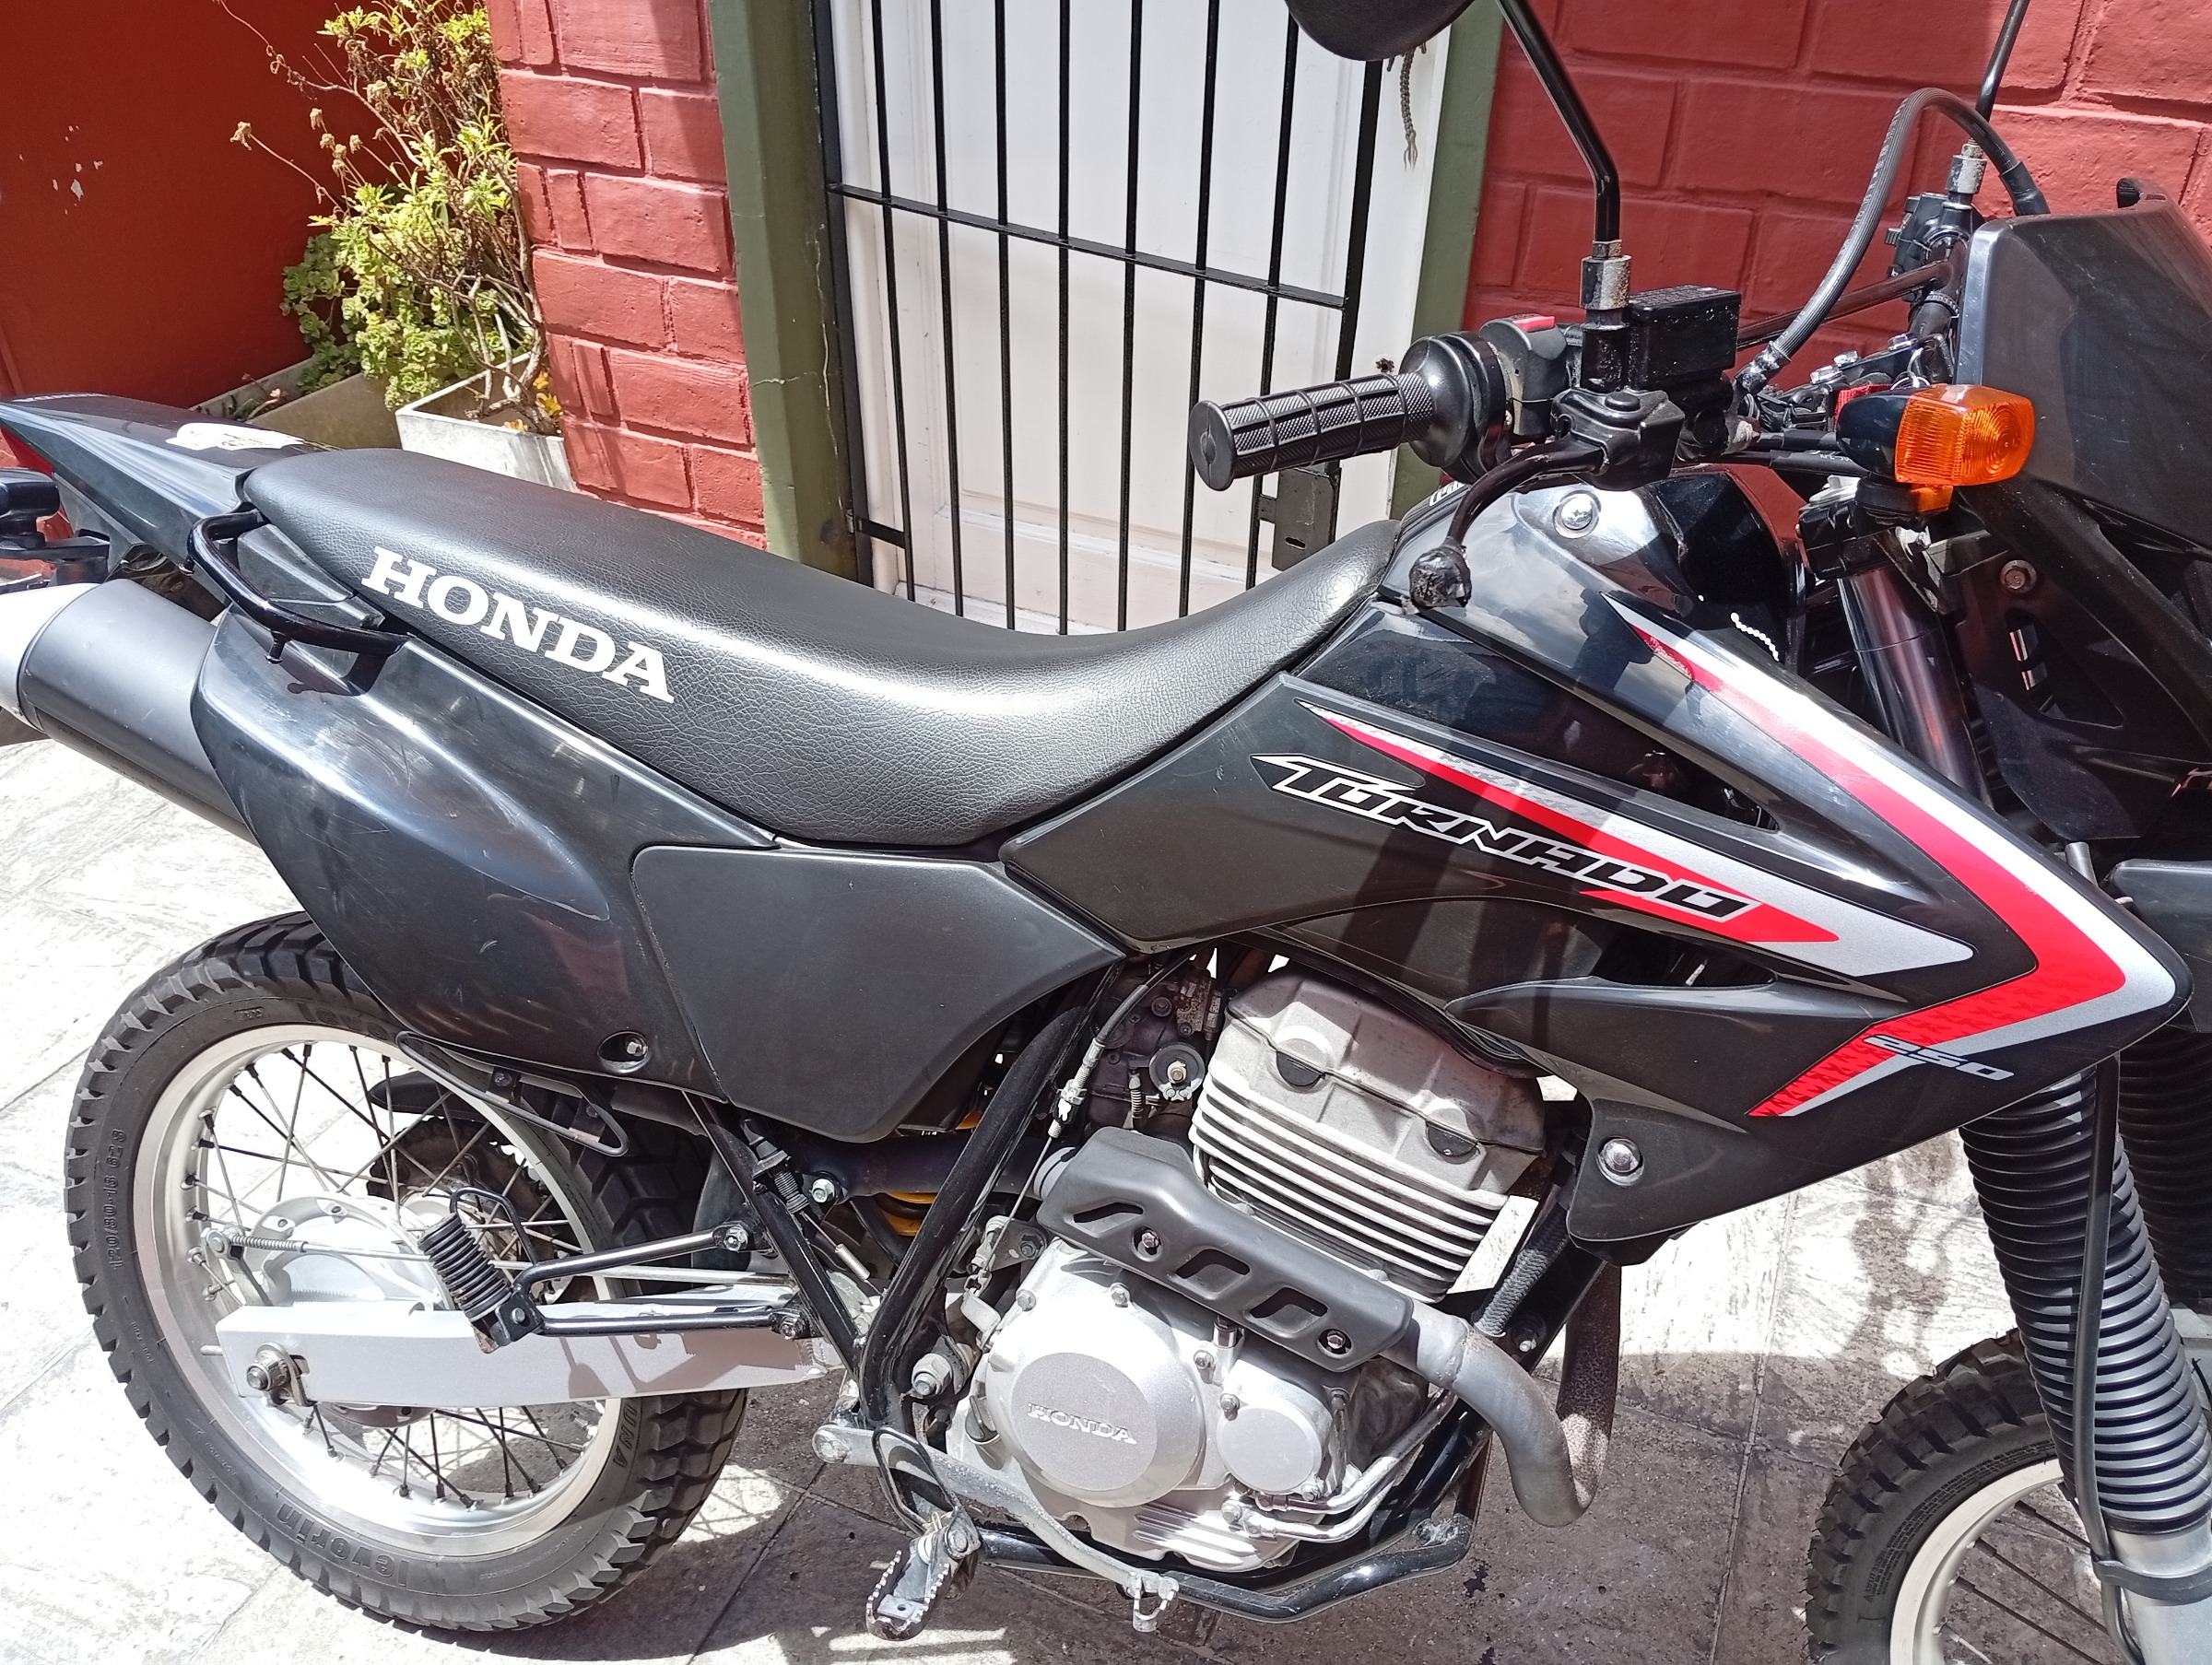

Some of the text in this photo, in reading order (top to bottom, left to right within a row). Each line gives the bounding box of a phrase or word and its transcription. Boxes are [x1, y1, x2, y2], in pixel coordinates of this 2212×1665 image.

[360, 545, 676, 704] HONDA
[1250, 753, 1763, 922] TORNADO
[1862, 1034, 2015, 1081] 250
[1027, 1401, 1137, 1446] HONDA
